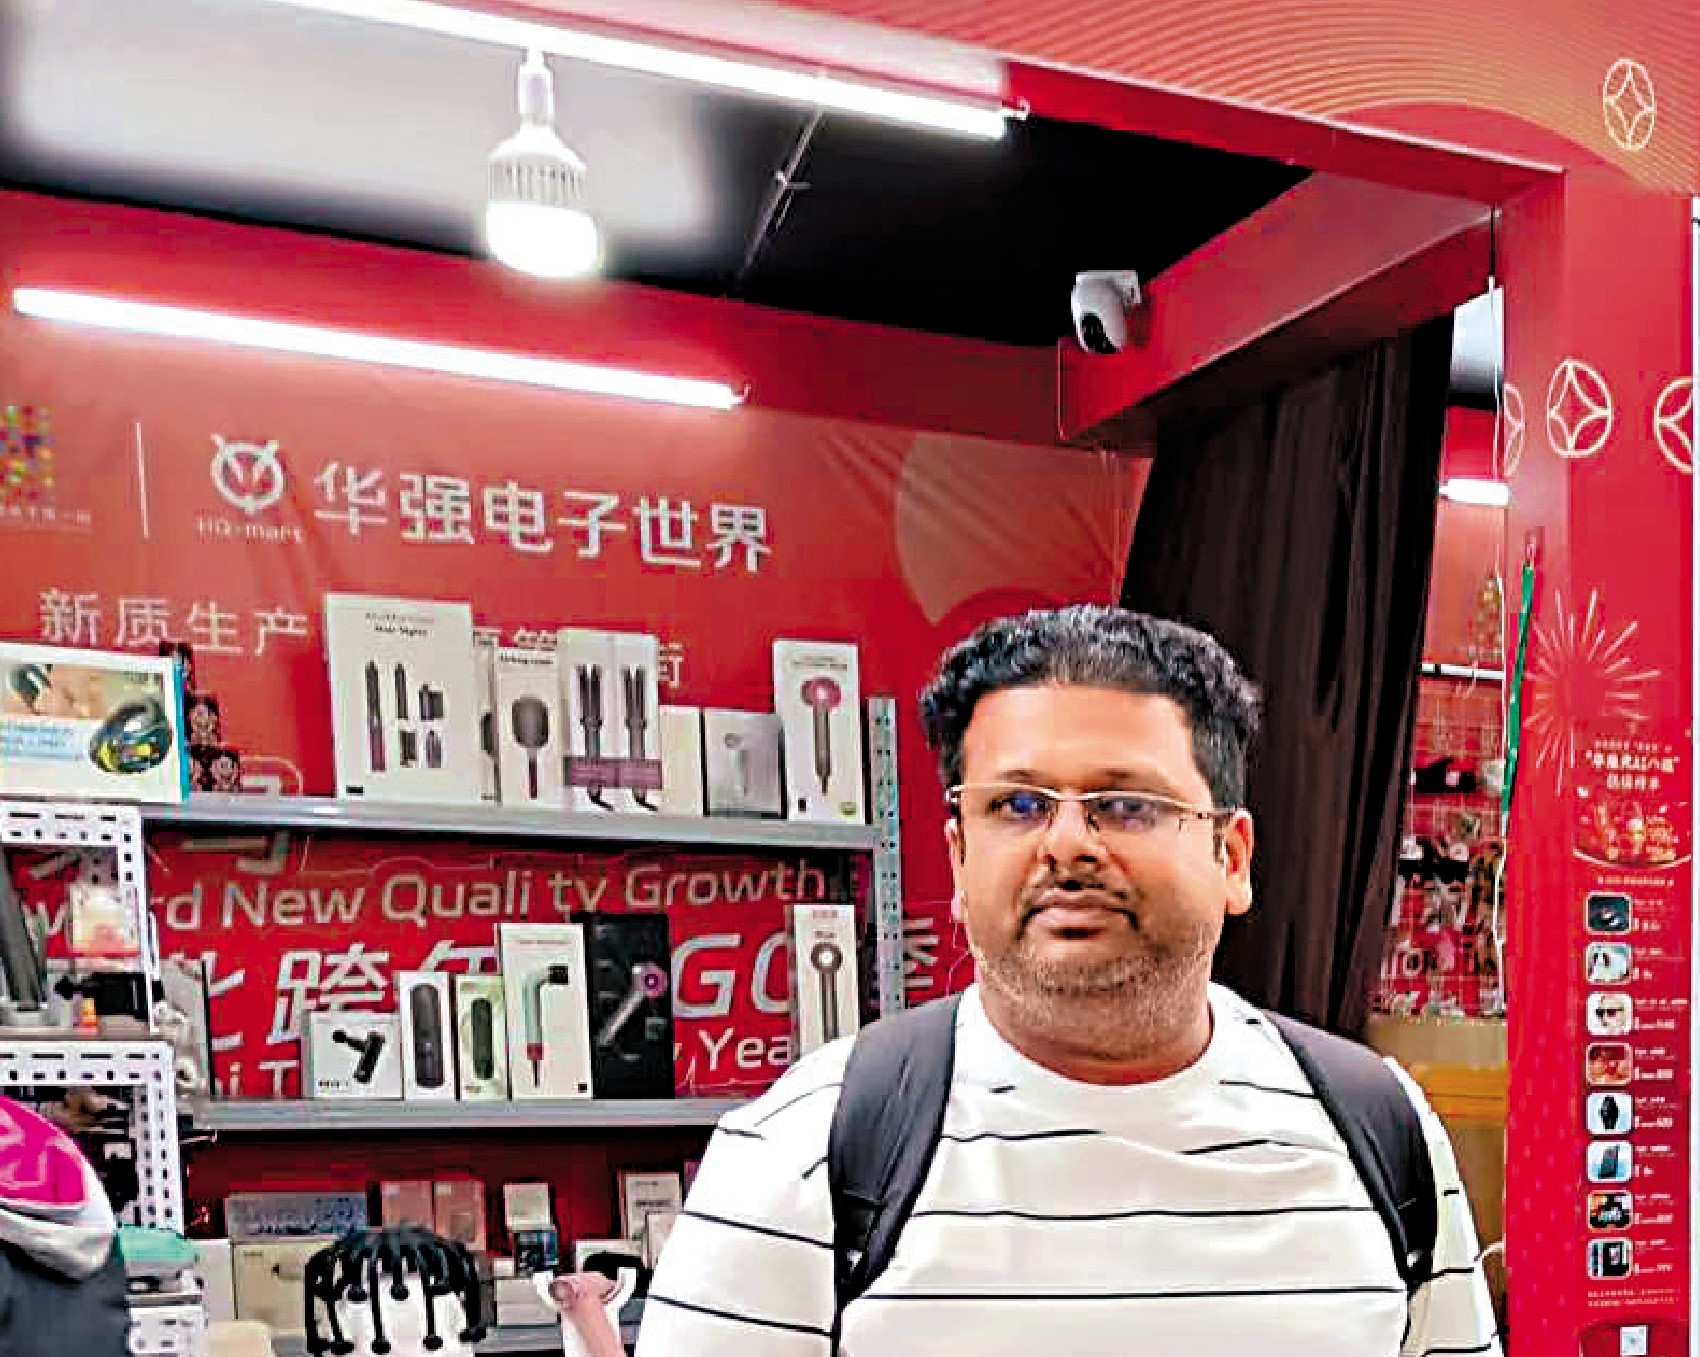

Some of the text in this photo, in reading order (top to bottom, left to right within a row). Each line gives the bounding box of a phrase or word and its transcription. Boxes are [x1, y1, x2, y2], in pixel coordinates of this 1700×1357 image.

[314, 461, 772, 573] 华强电子世界
[222, 880, 365, 927] New
[626, 860, 826, 908] Growth
[699, 1027, 792, 1072] Yea
